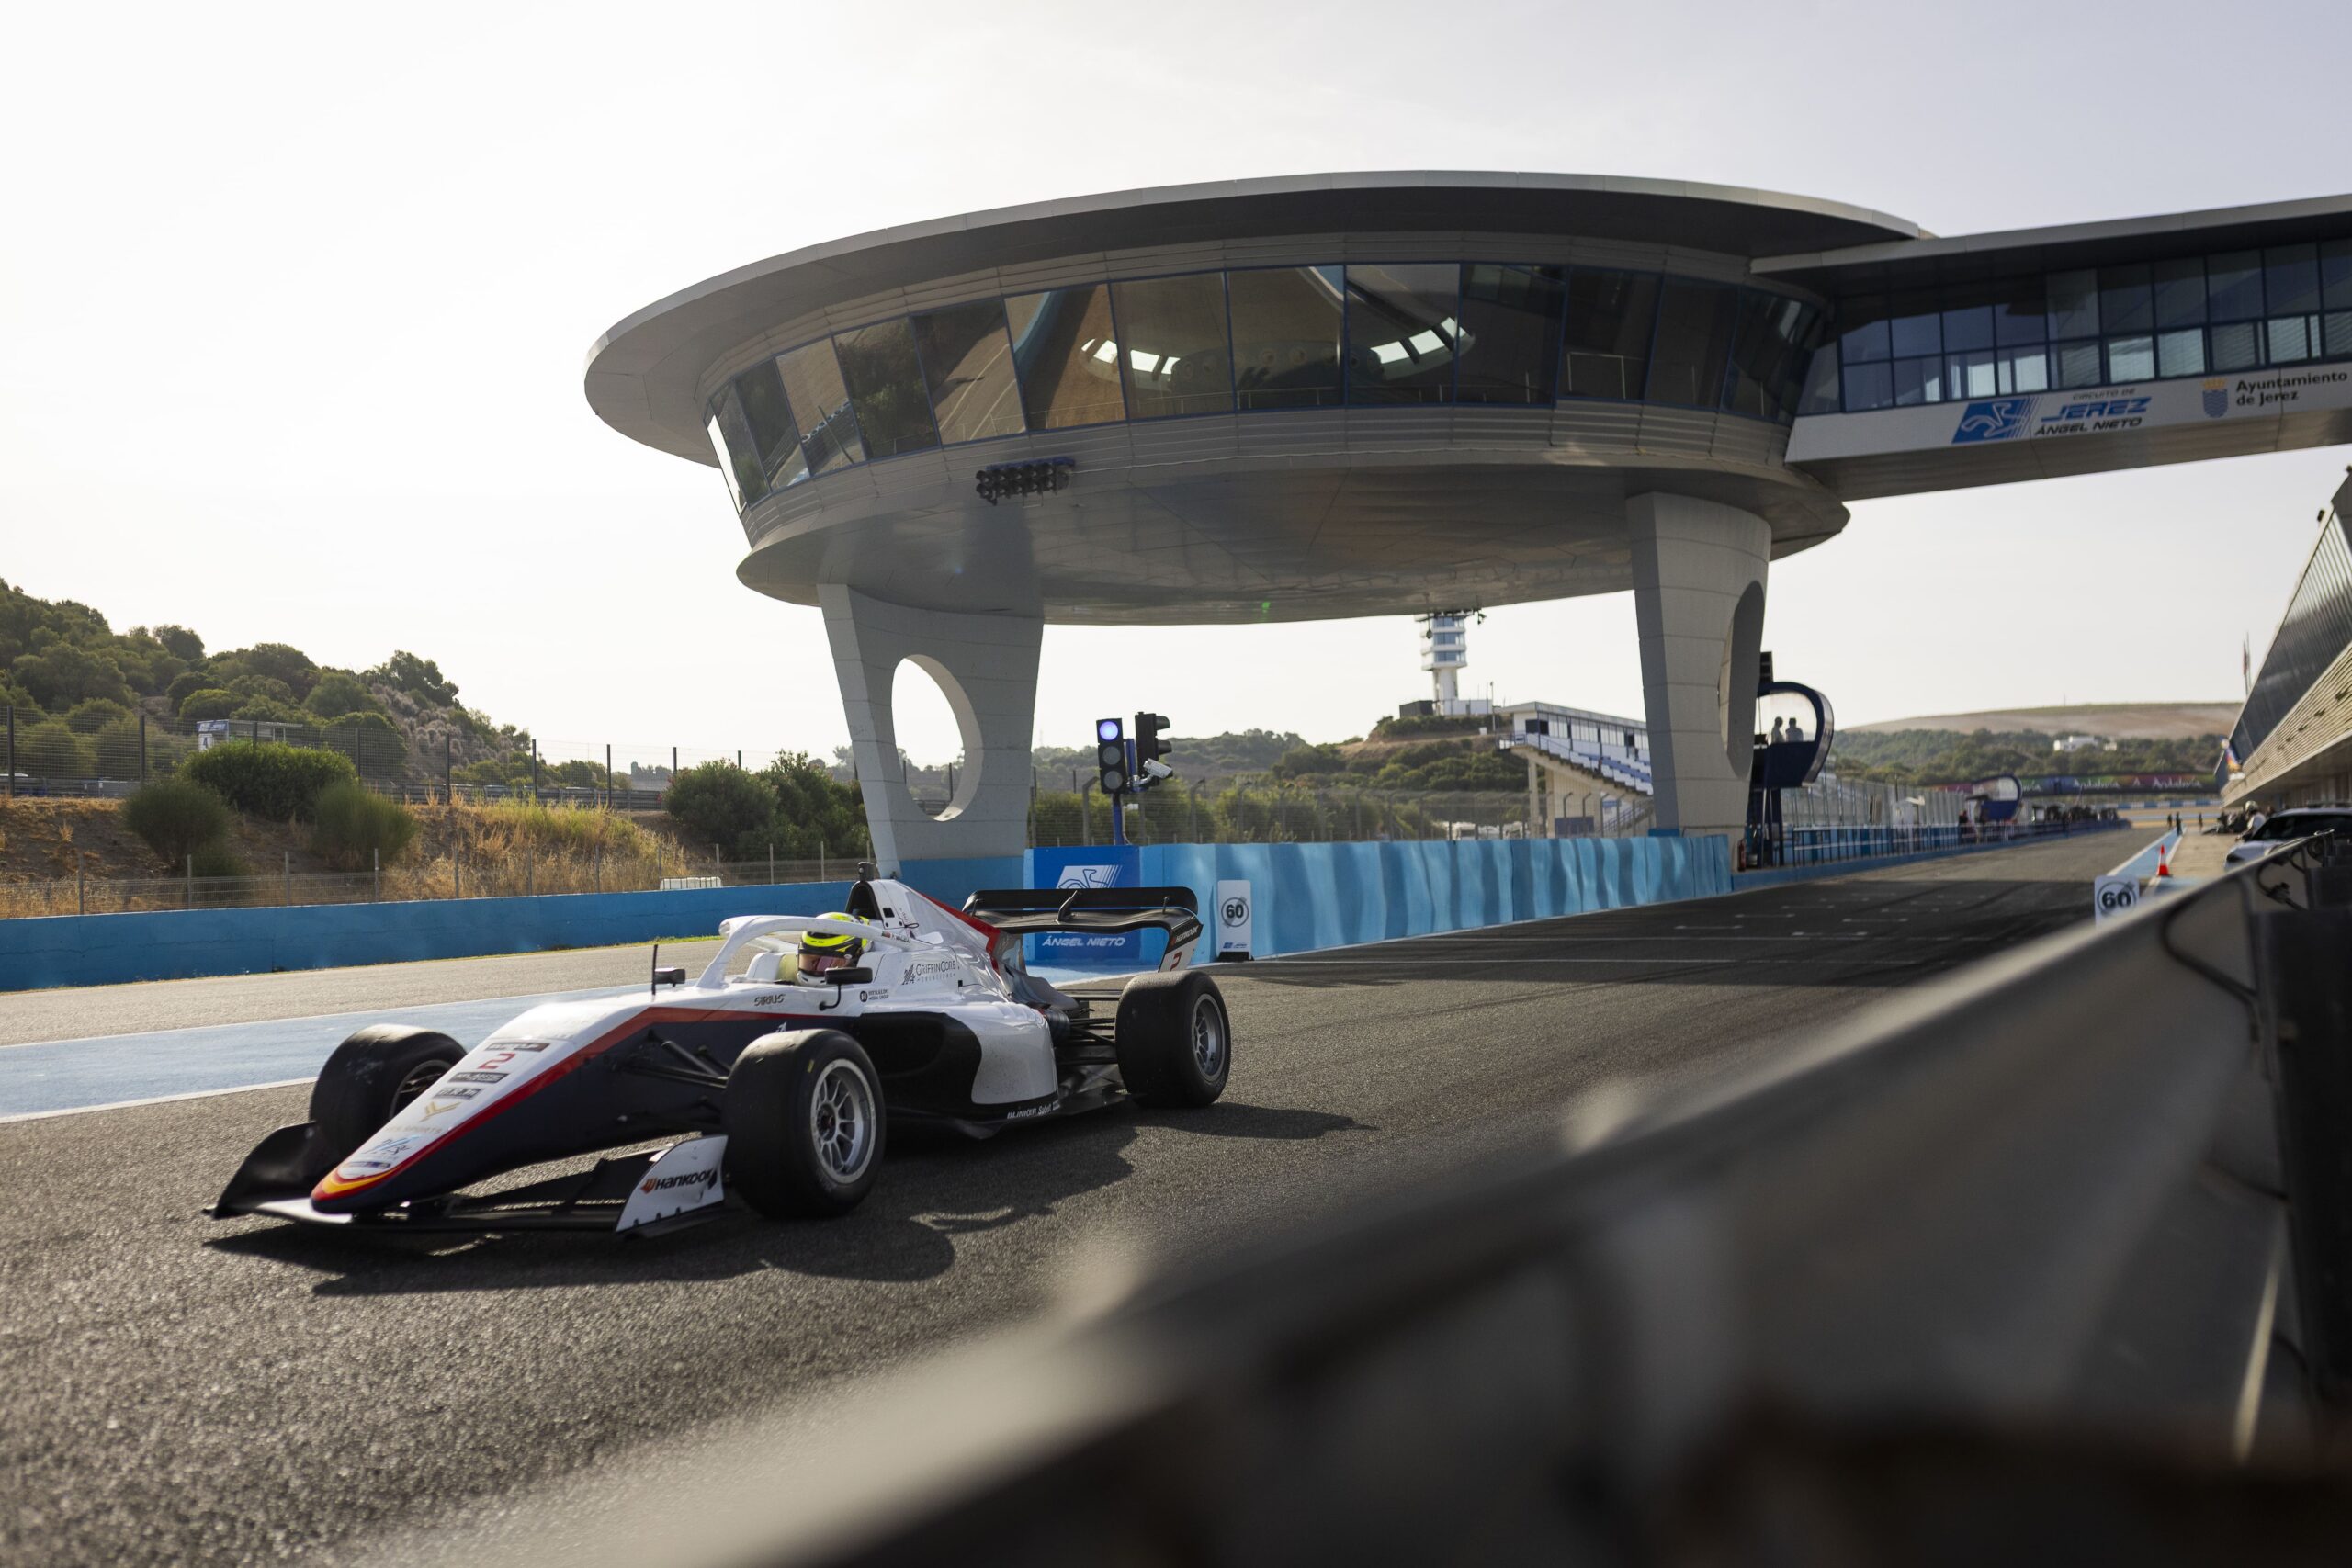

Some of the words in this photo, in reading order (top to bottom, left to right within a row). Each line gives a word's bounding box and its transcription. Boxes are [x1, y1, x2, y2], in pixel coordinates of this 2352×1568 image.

[2236, 372, 2348, 394] Ayuntamiento
[2073, 389, 2119, 401] CIRCUITO
[2236, 394, 2255, 406] de
[2259, 390, 2299, 407] Jerez
[2041, 396, 2152, 422] JEREZ
[2093, 416, 2143, 431] NIETO
[2101, 891, 2132, 909] 60
[1226, 904, 1244, 919] 60
[1042, 935, 1084, 947] ÁNGEL
[1087, 937, 1125, 947] NIETO
[754, 993, 786, 1007] SIRIUS
[478, 1053, 516, 1069] 2
